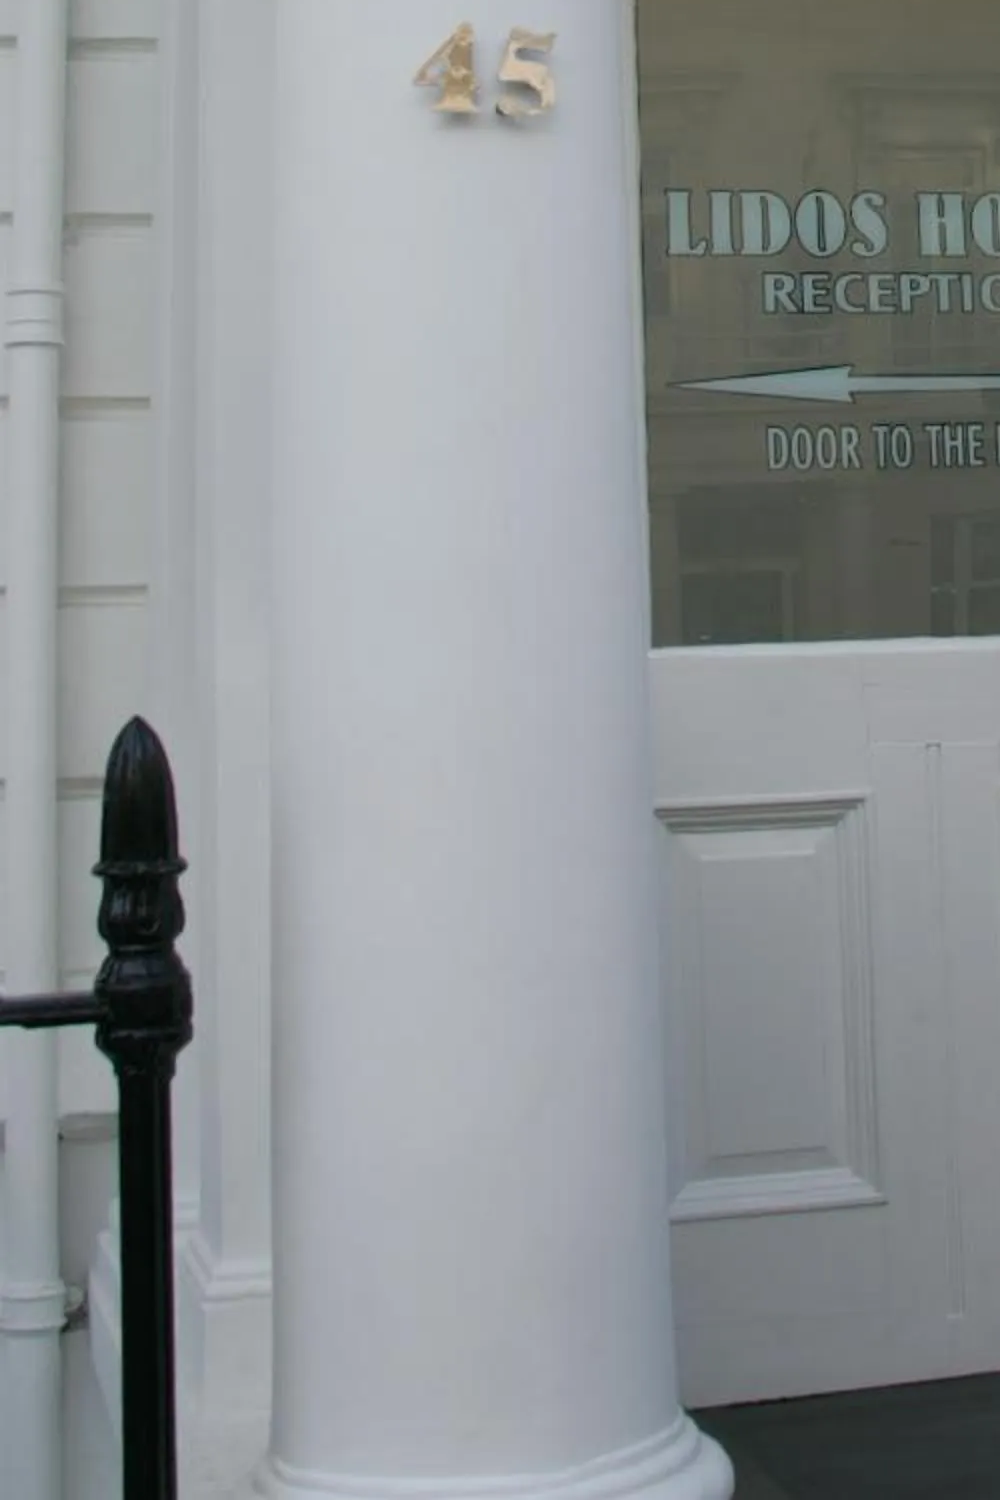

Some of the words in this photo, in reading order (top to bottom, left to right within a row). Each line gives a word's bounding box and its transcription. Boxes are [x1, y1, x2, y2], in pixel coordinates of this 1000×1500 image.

[413, 20, 557, 118] 45
[665, 188, 889, 259] LIDOS
[766, 424, 861, 471] DOOR
[872, 423, 912, 469] TO
[924, 422, 984, 468] THE
